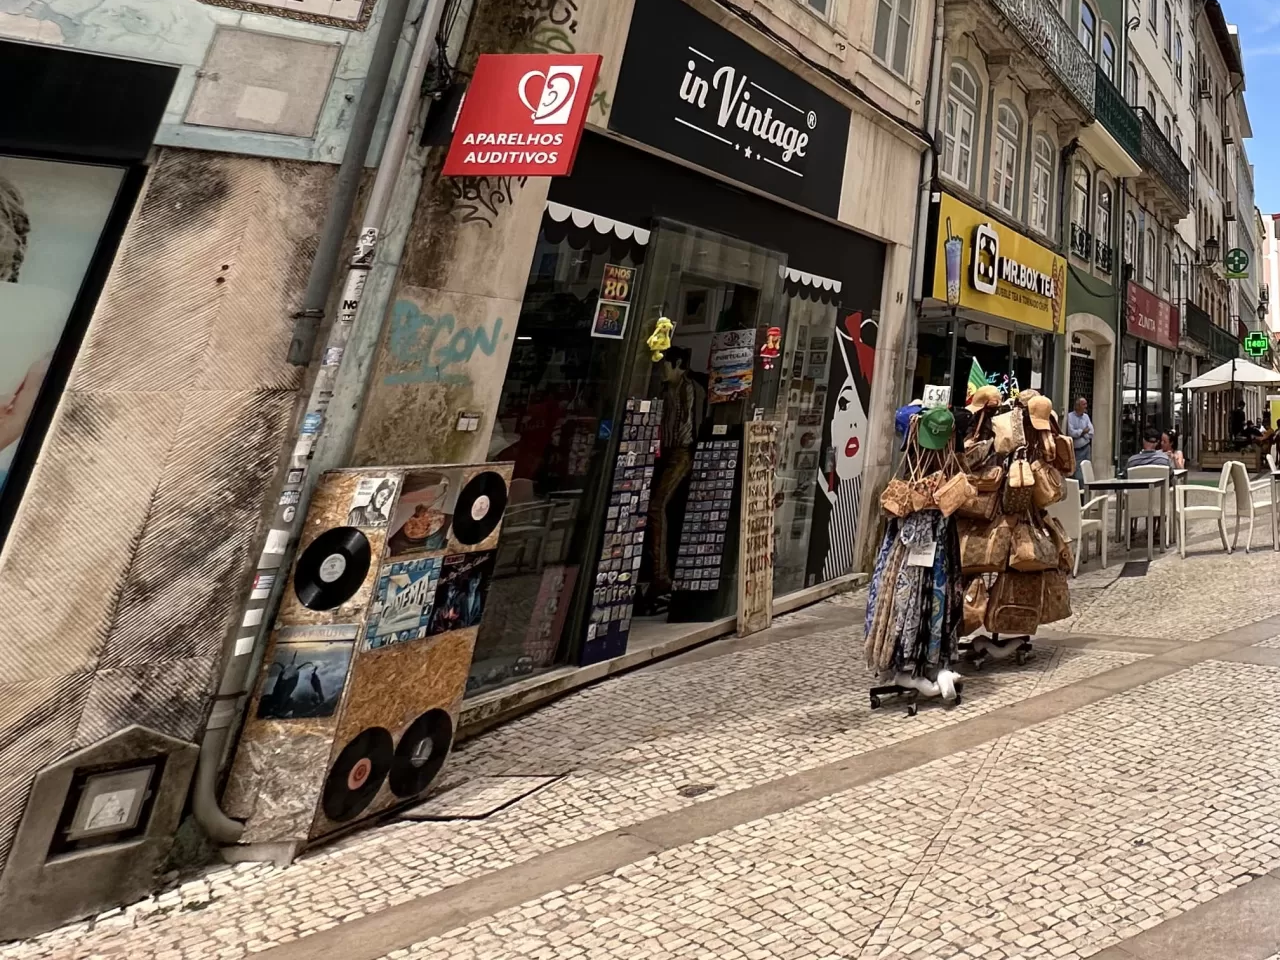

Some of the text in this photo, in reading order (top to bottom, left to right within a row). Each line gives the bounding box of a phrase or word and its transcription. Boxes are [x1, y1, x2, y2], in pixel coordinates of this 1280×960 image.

[679, 60, 809, 163] in Vintage
[462, 133, 564, 146] APARELHOS
[463, 151, 559, 164] AUDITIVOS
[608, 266, 632, 280] ANOS
[1002, 256, 1056, 299] MR.BOX TEA
[604, 280, 629, 298] 80
